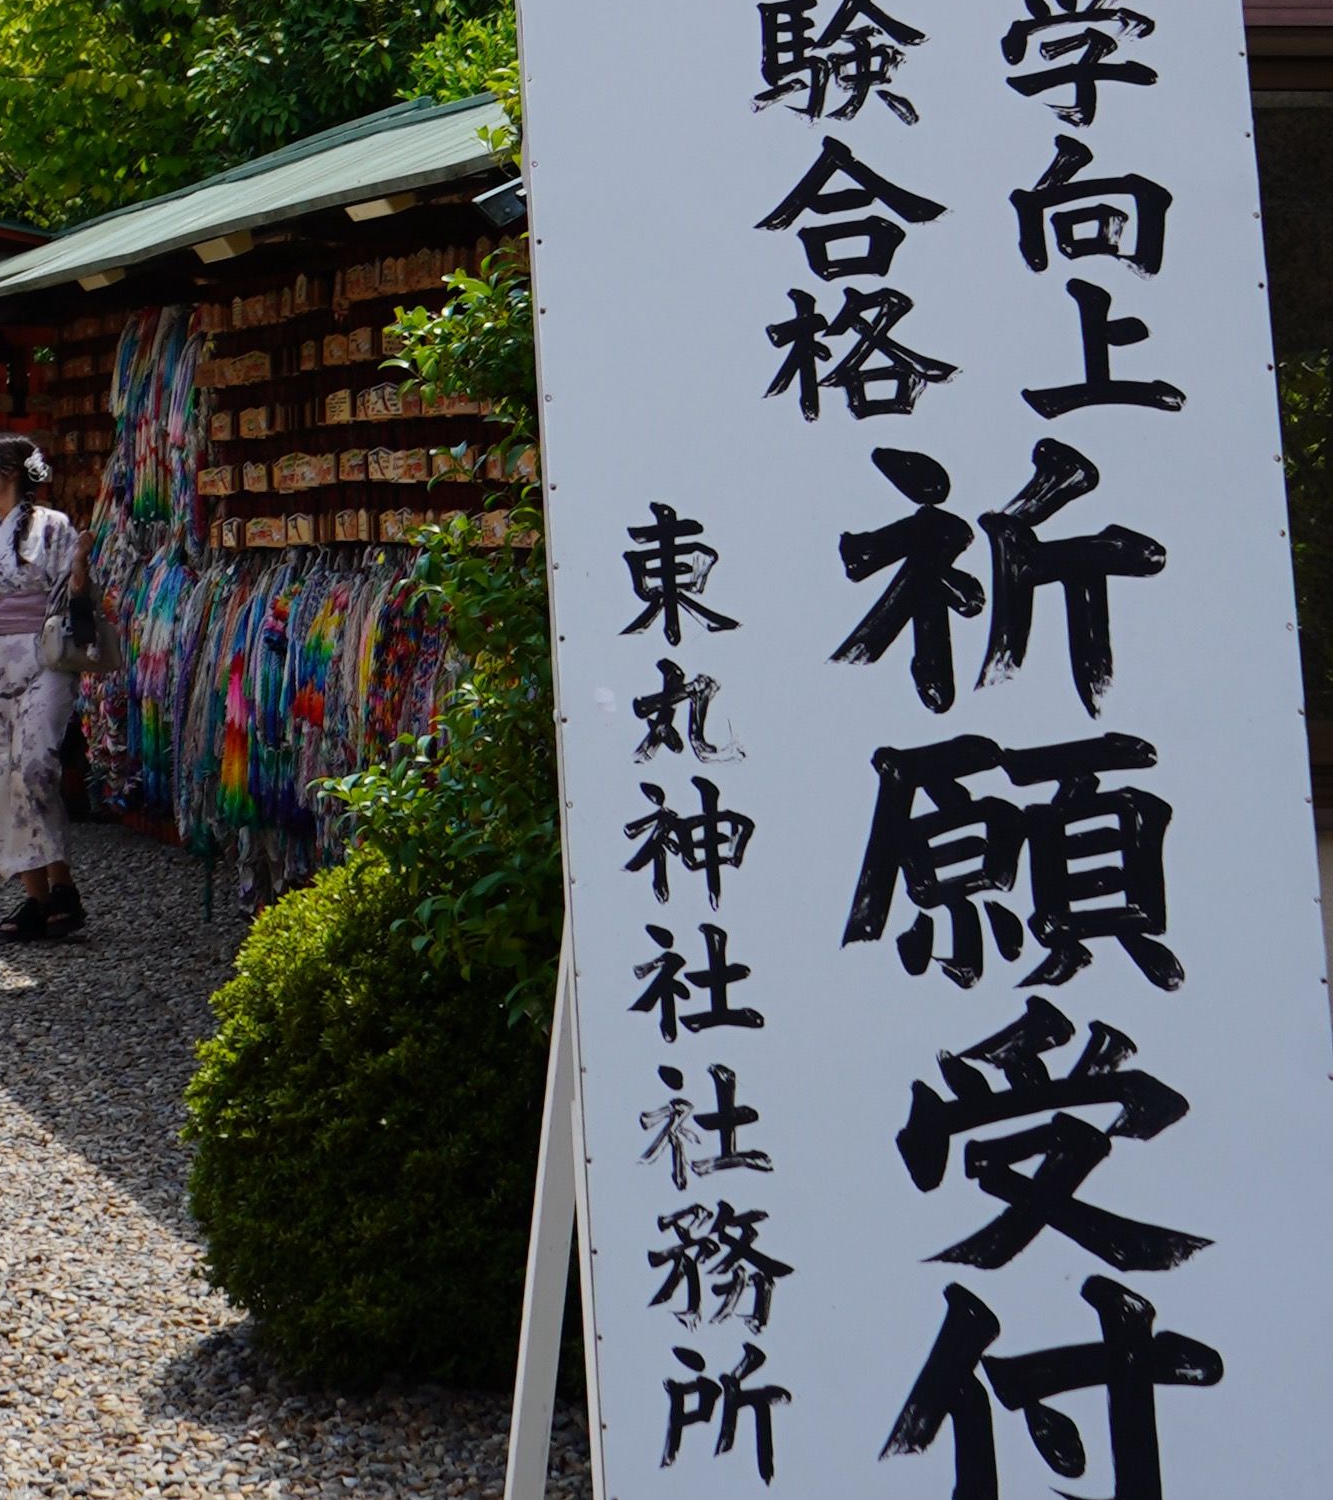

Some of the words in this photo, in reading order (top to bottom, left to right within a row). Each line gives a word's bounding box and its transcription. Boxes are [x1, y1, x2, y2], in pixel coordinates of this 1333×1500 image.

[617, 500, 796, 1488] 東丸神社社務所
